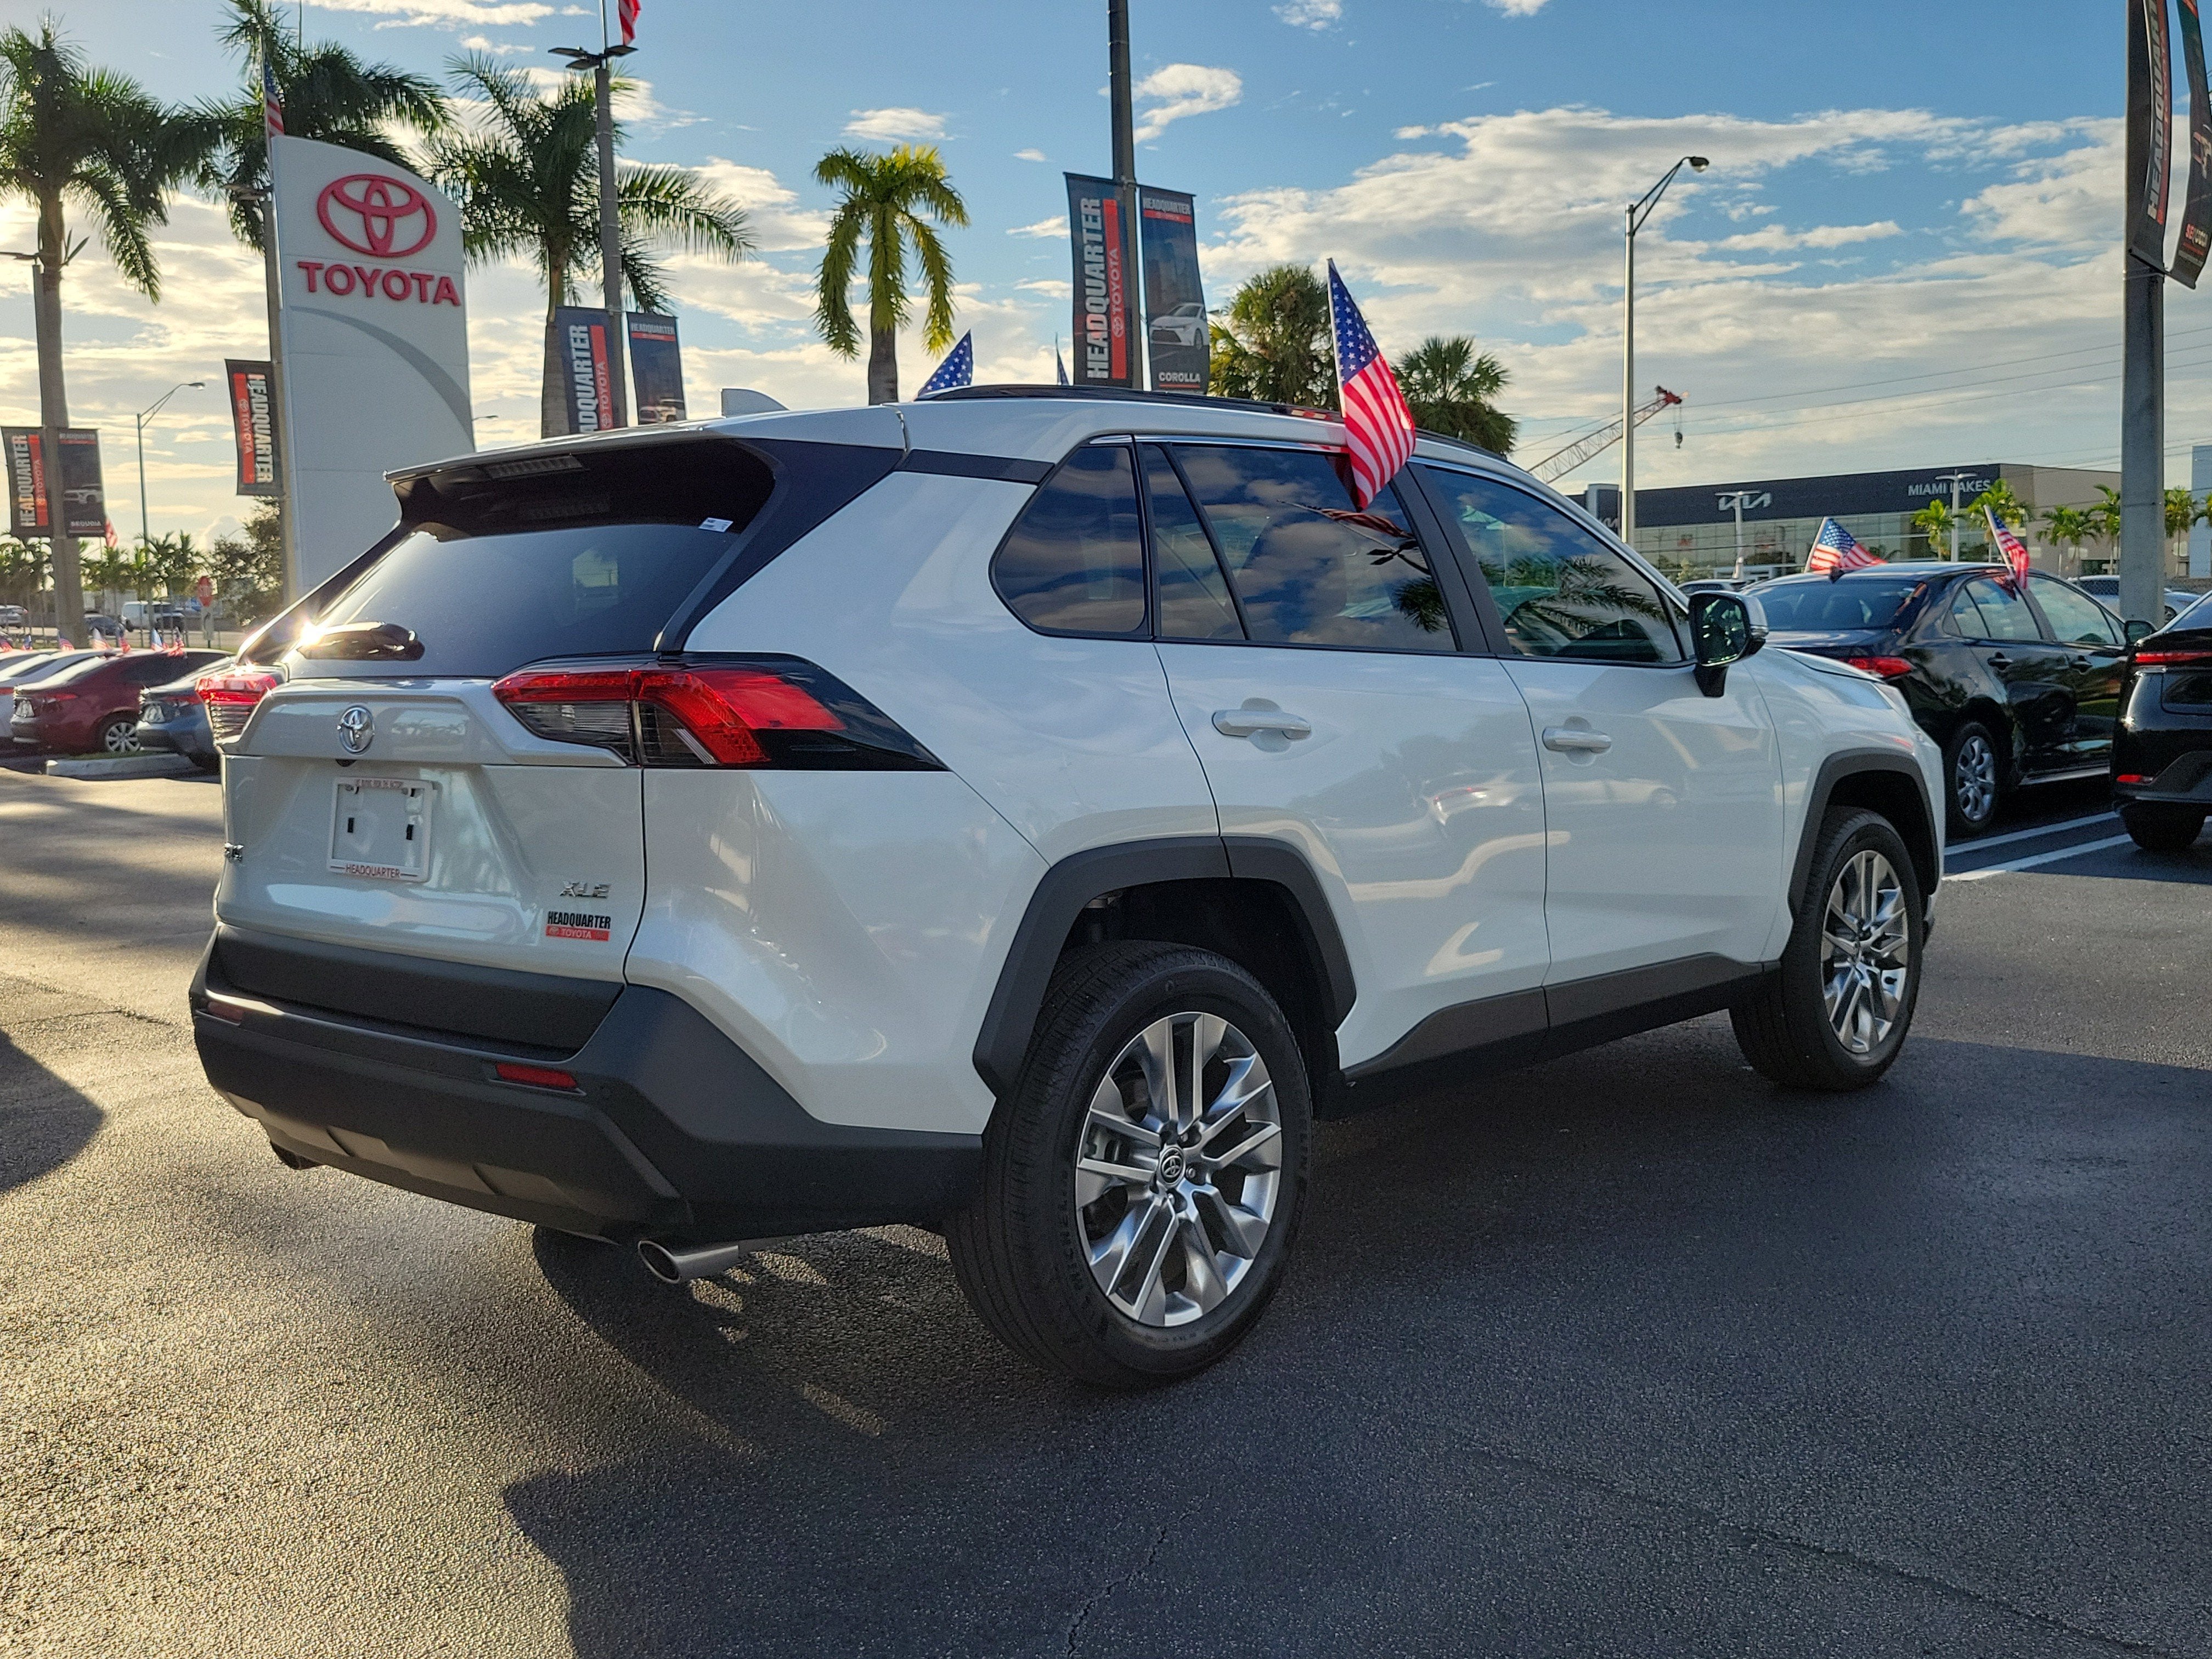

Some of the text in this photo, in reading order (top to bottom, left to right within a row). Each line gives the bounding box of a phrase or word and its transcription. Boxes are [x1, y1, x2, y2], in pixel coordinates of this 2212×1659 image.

[2147, 0, 2164, 219] HEADQUART
[297, 261, 461, 306] TOYOTA
[1081, 198, 1110, 379] HEADQUARTER
[1109, 248, 1123, 314] TOYOTA
[569, 325, 599, 433] ADQUARTER
[595, 362, 609, 411] TOYOTA
[1158, 372, 1200, 383] COROLLA
[240, 413, 253, 454] TOYOTA
[247, 374, 274, 483] HEADQUARTER
[12, 435, 36, 527] HEADQUARTER
[33, 460, 46, 499] TOYOTA
[1908, 479, 1991, 496] MIAMI LAKES
[345, 863, 401, 878] HEADQUARTER
[560, 880, 612, 899] XLE
[548, 910, 611, 929] HEADQUARTER
[561, 928, 592, 939] TOYOTA
